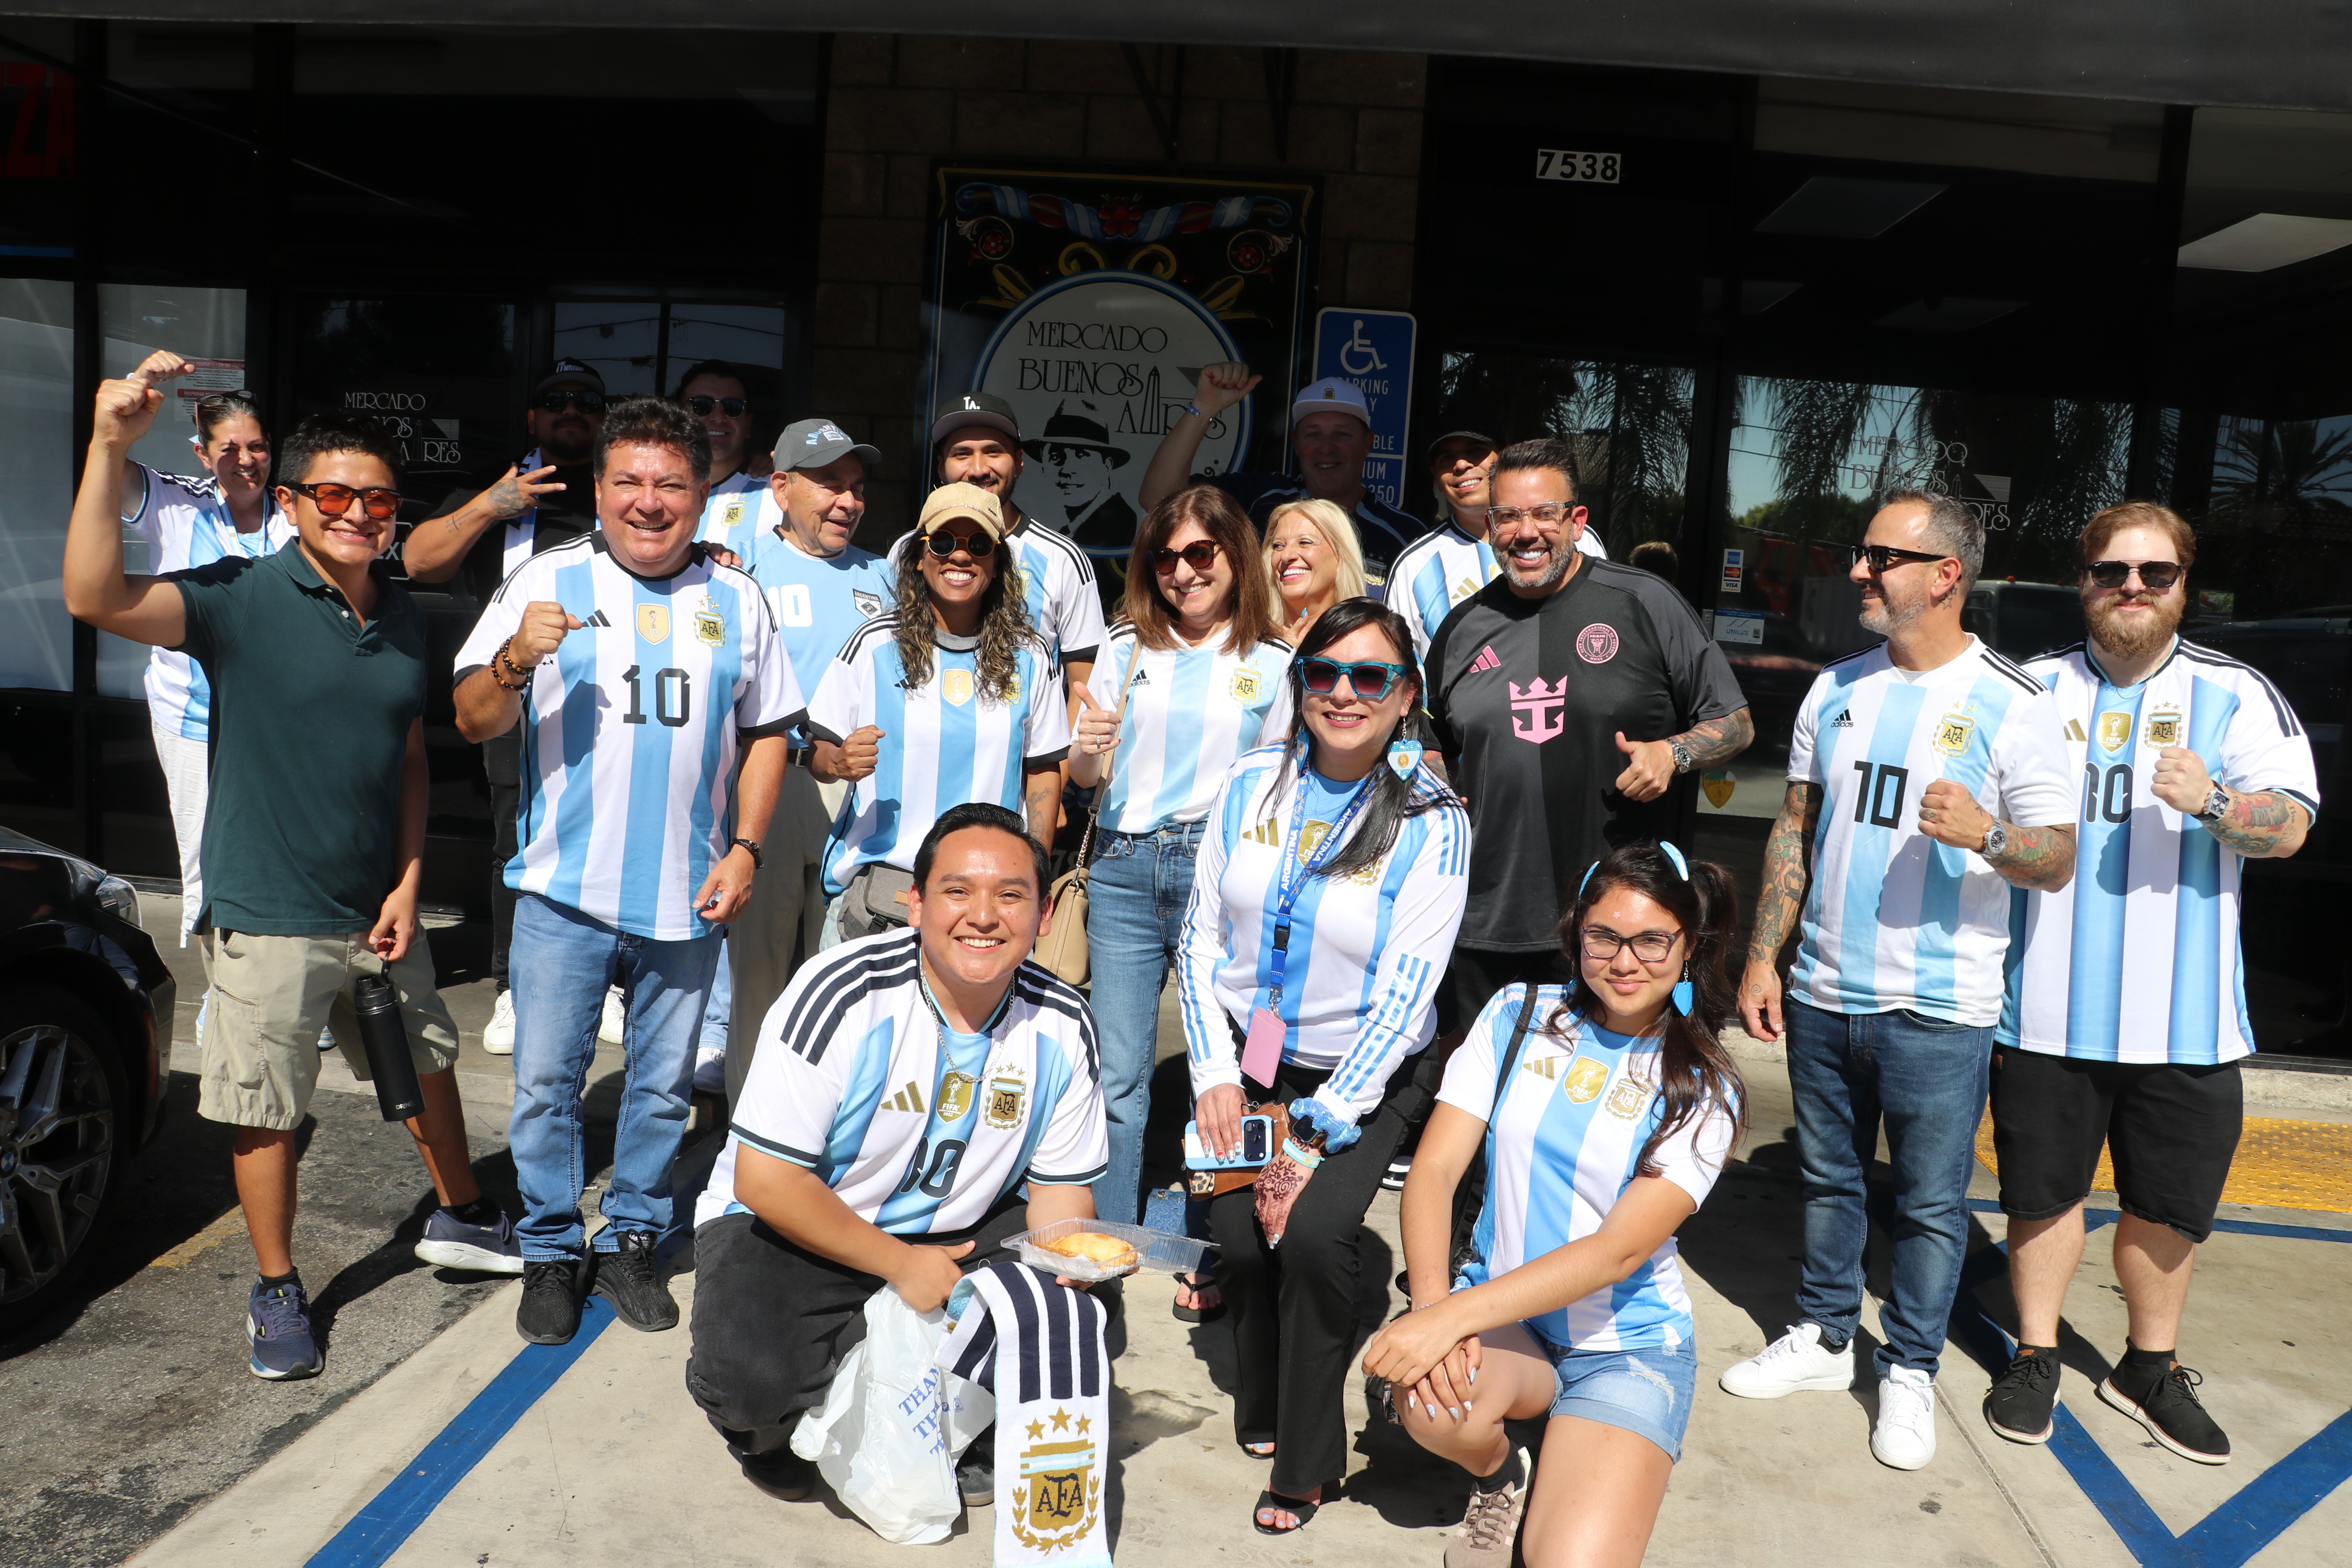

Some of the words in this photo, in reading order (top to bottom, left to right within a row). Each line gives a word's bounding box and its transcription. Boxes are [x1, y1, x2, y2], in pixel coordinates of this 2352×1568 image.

[0, 62, 75, 178] ZA
[1538, 151, 1618, 181] 7538
[1027, 321, 1168, 353] MERCADO
[1017, 358, 1144, 397] BUENOS
[345, 392, 426, 410] MERCADO
[1858, 435, 1968, 463] MERCADO
[727, 508, 739, 520] AFA
[854, 591, 879, 601] ARGENTINA
[701, 619, 719, 637] AFA
[1128, 679, 1150, 688] adidas
[1236, 677, 1254, 695] AFA
[621, 664, 691, 728] 10
[1942, 724, 1963, 745] AFA
[2152, 722, 2174, 739] AFA
[1854, 760, 1909, 830] 10
[2085, 761, 2134, 824] 10
[1312, 807, 1353, 862] ARGENTINA
[1281, 829, 1298, 891] ARGENTINA
[1303, 849, 1315, 857] FIF
[1572, 1085, 1591, 1096] FIFA
[1615, 1088, 1637, 1108] AFA
[942, 1103, 960, 1111] FIFA
[993, 1091, 1016, 1116] AFA
[1908, 1373, 1925, 1385] adidas
[1035, 1472, 1083, 1517] AFA
